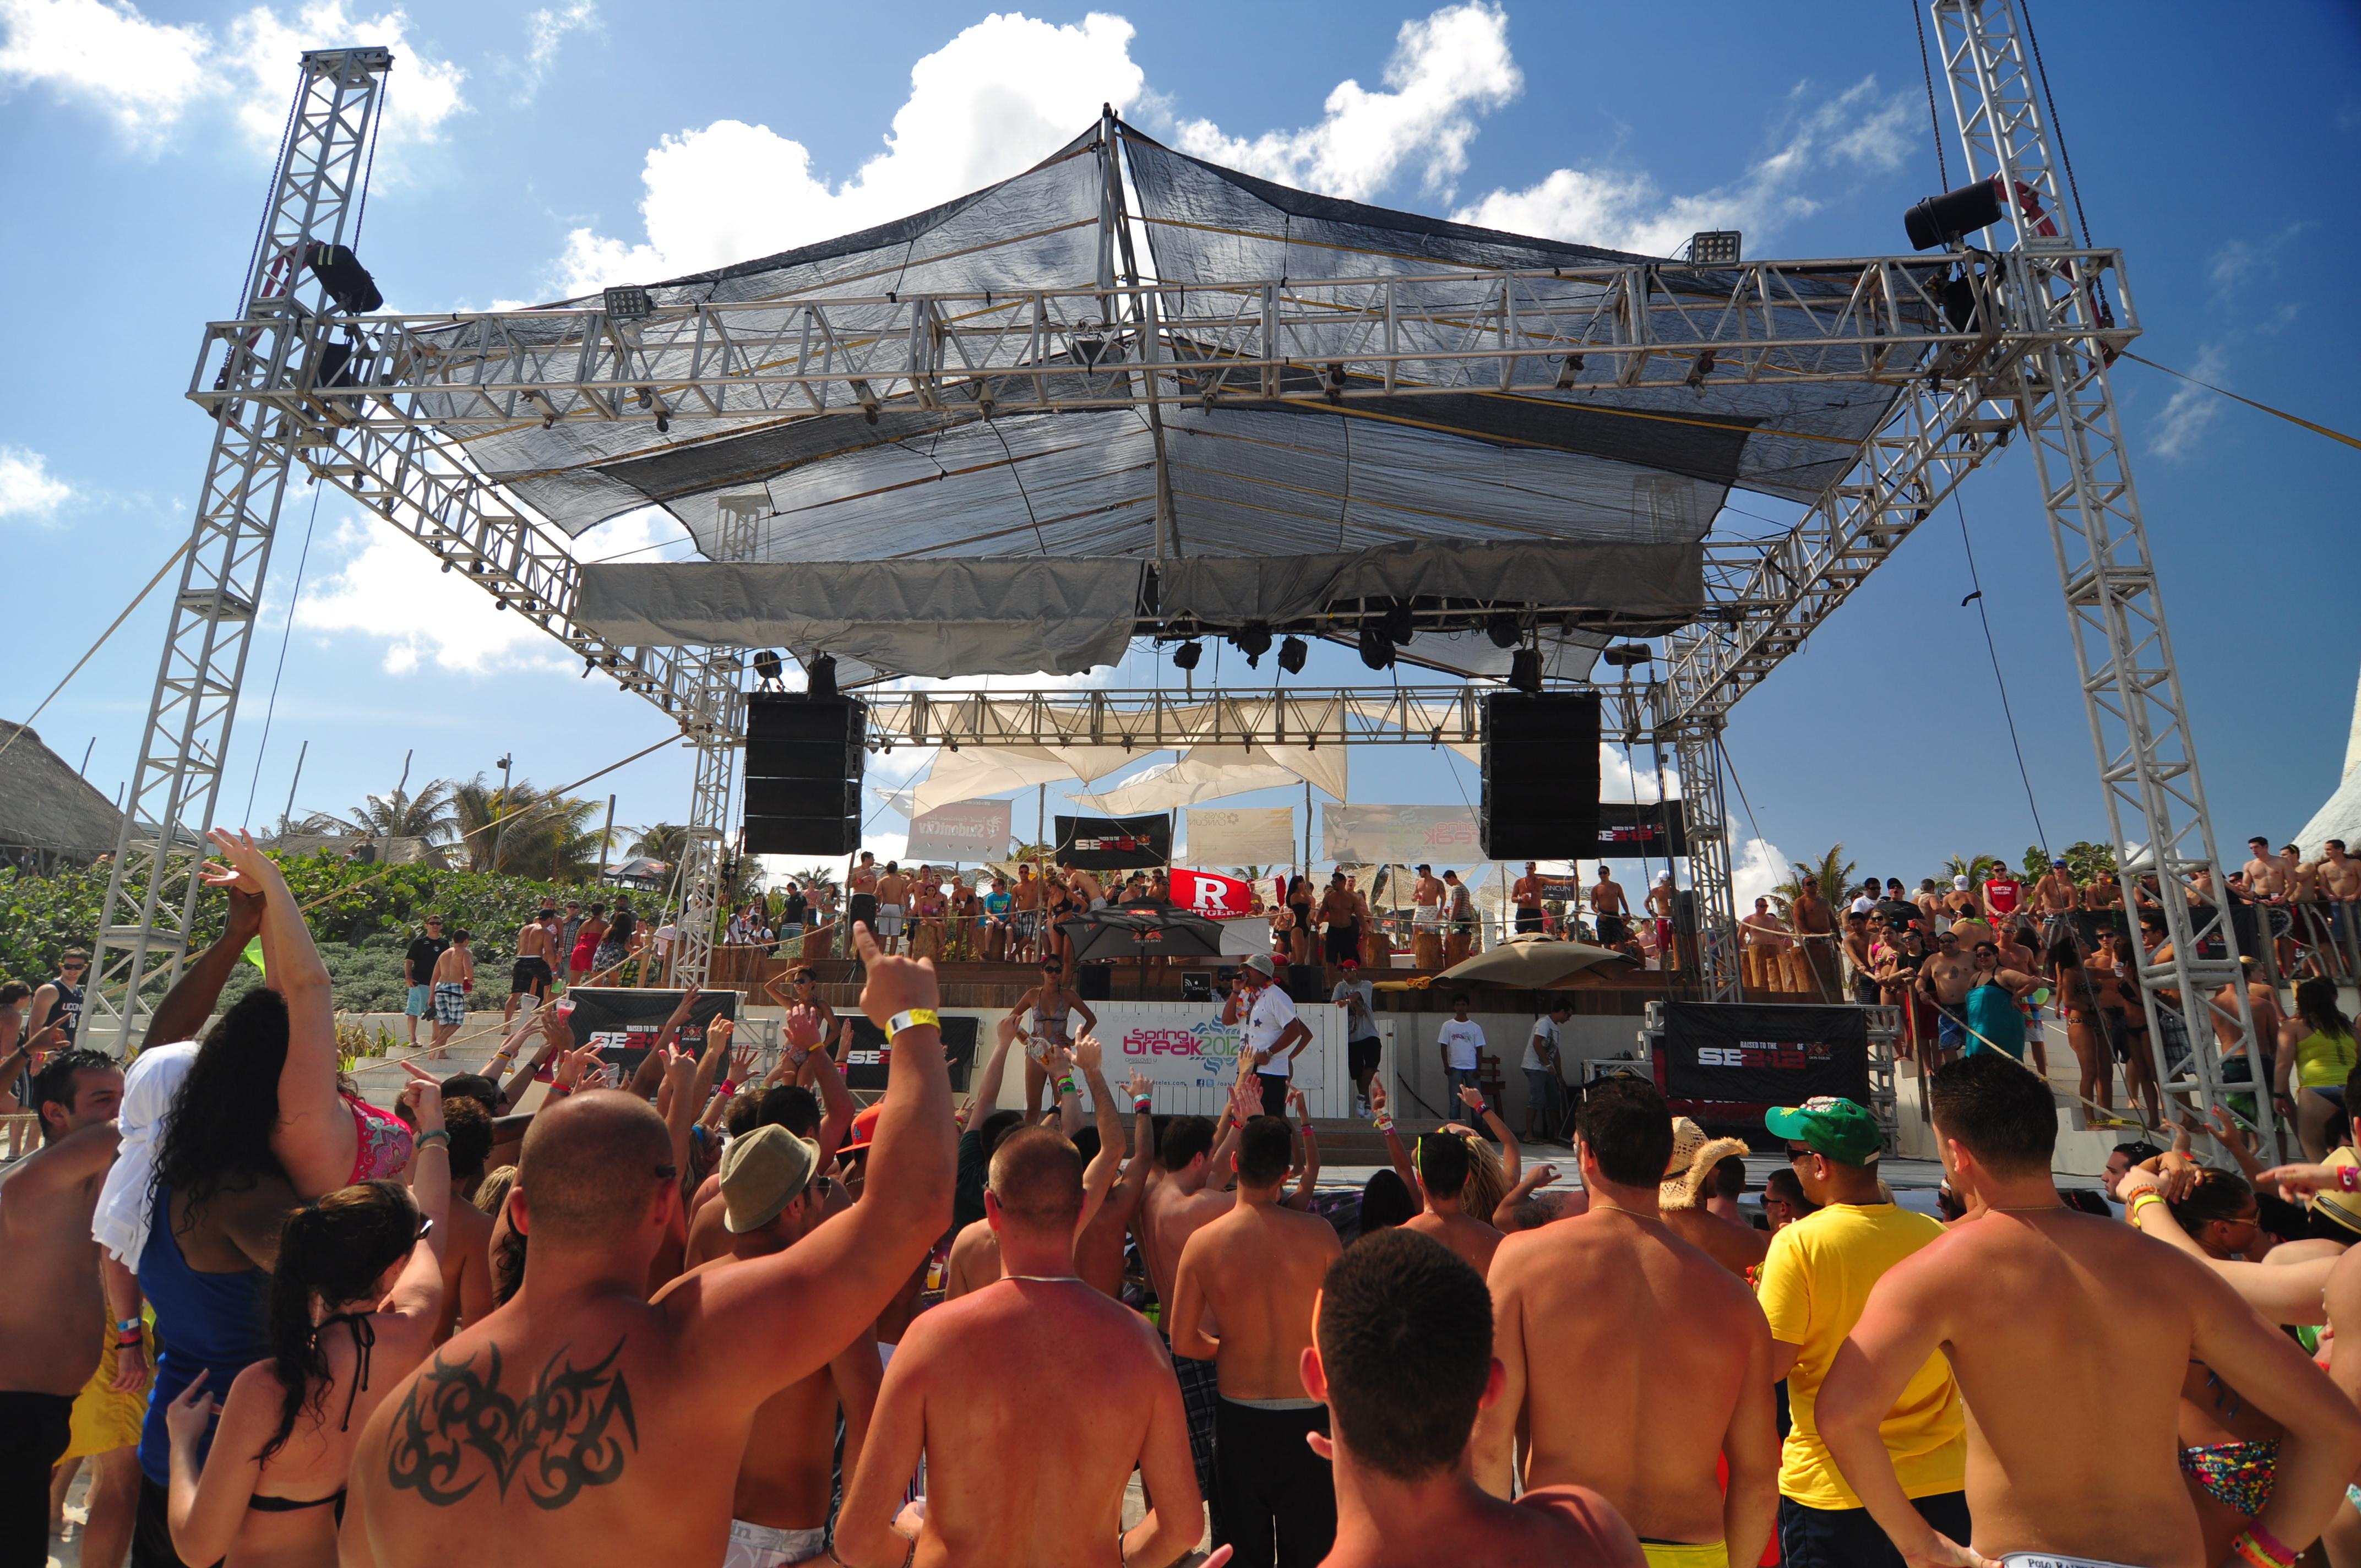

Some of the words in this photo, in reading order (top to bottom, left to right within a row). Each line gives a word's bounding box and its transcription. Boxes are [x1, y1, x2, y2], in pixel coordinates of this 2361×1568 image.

[1193, 876, 1229, 910] R
[1132, 1028, 1189, 1044] Spring
[1123, 1036, 1203, 1055] break
[1740, 1041, 1759, 1049] RAISED
